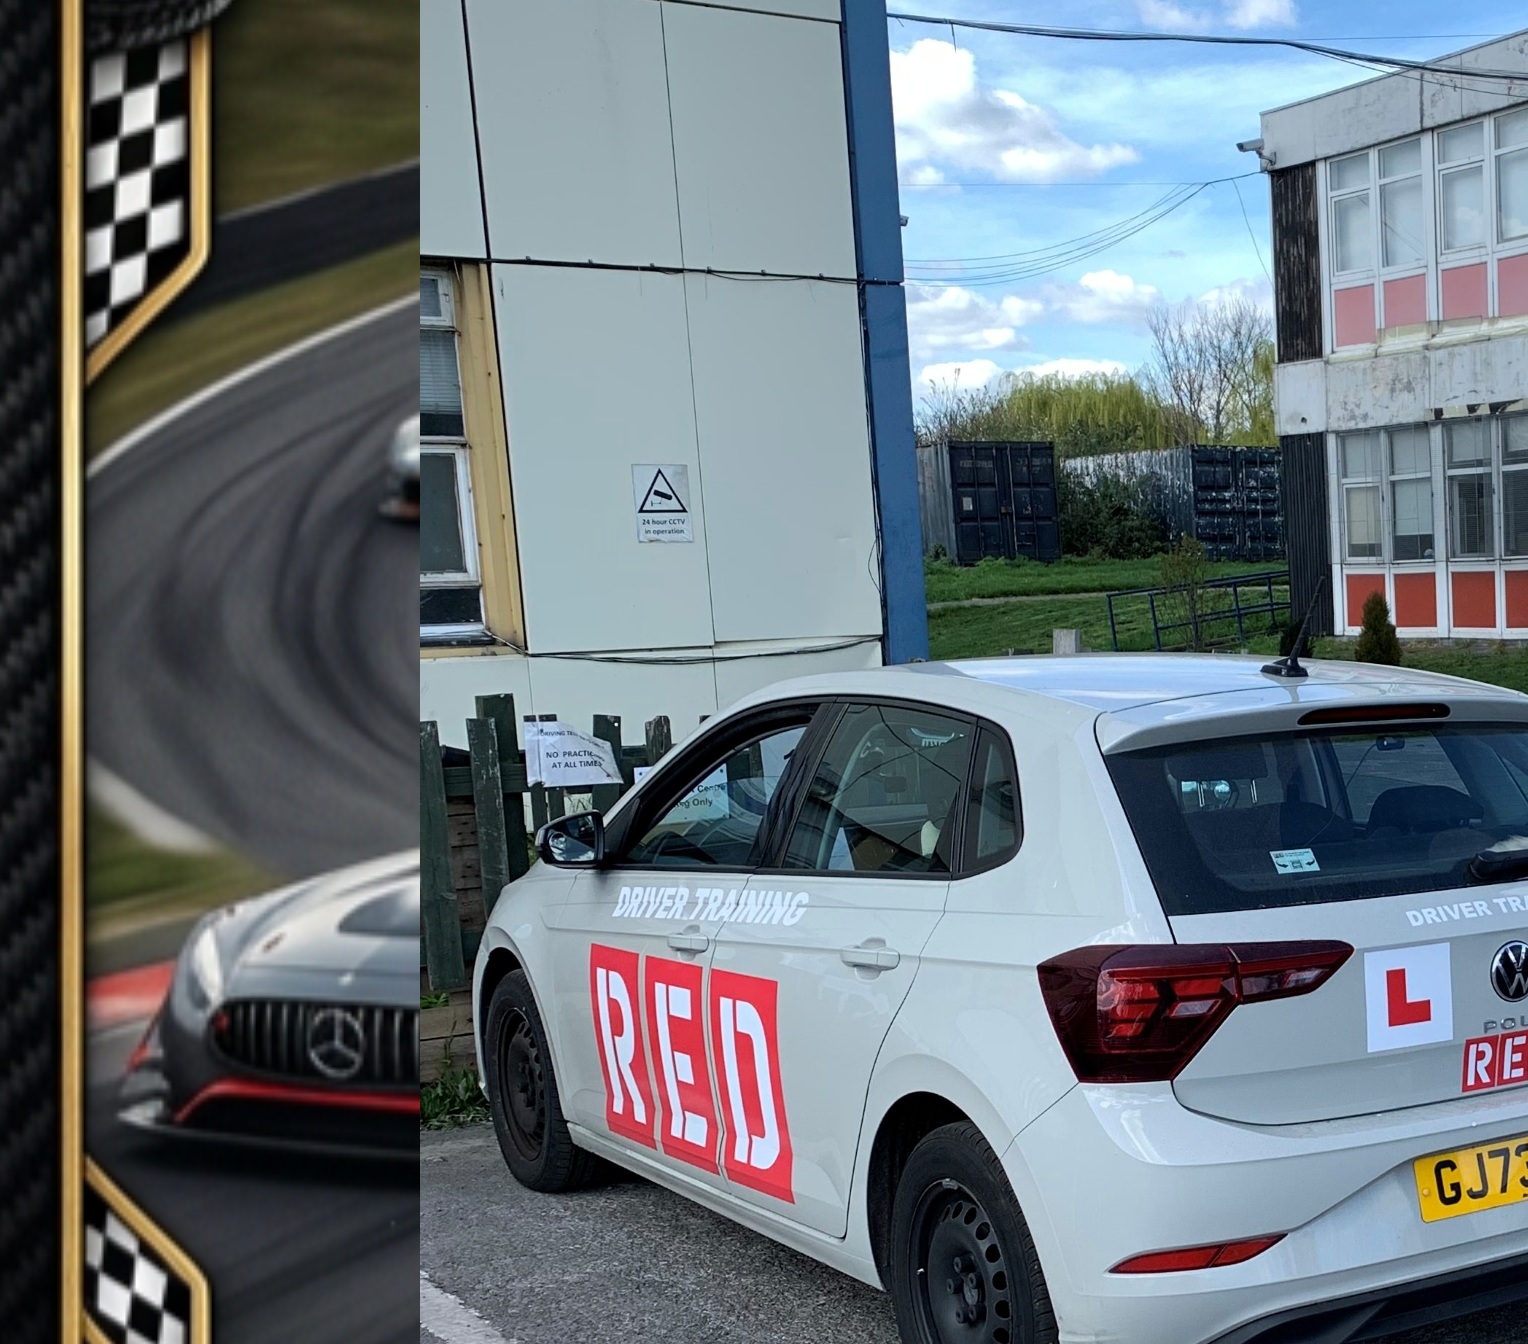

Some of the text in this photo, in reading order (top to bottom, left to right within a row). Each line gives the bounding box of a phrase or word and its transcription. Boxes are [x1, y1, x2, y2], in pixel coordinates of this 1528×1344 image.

[546, 751, 559, 759] NO
[692, 798, 713, 807] Only
[611, 886, 810, 926] DRIVER TRAINING
[1405, 899, 1493, 927] DRIVER
[1385, 967, 1432, 1027] L
[596, 966, 781, 1171] RED
